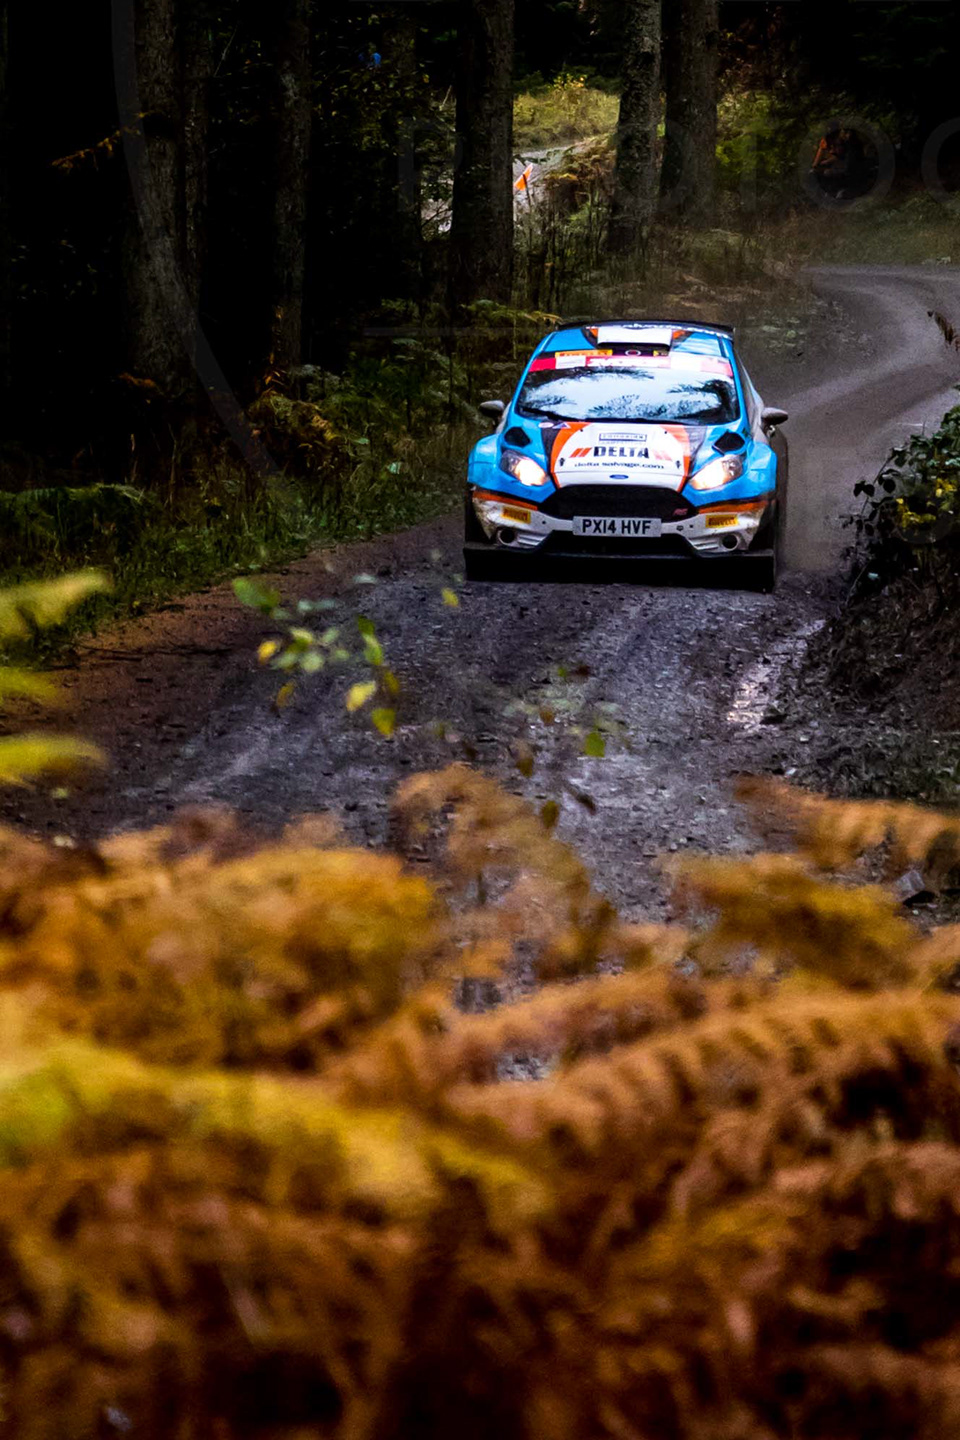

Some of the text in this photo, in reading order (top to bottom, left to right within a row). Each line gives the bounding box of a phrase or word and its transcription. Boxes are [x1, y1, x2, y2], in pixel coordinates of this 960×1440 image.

[593, 446, 649, 459] DELTA
[582, 519, 652, 535] PX14 HVF
